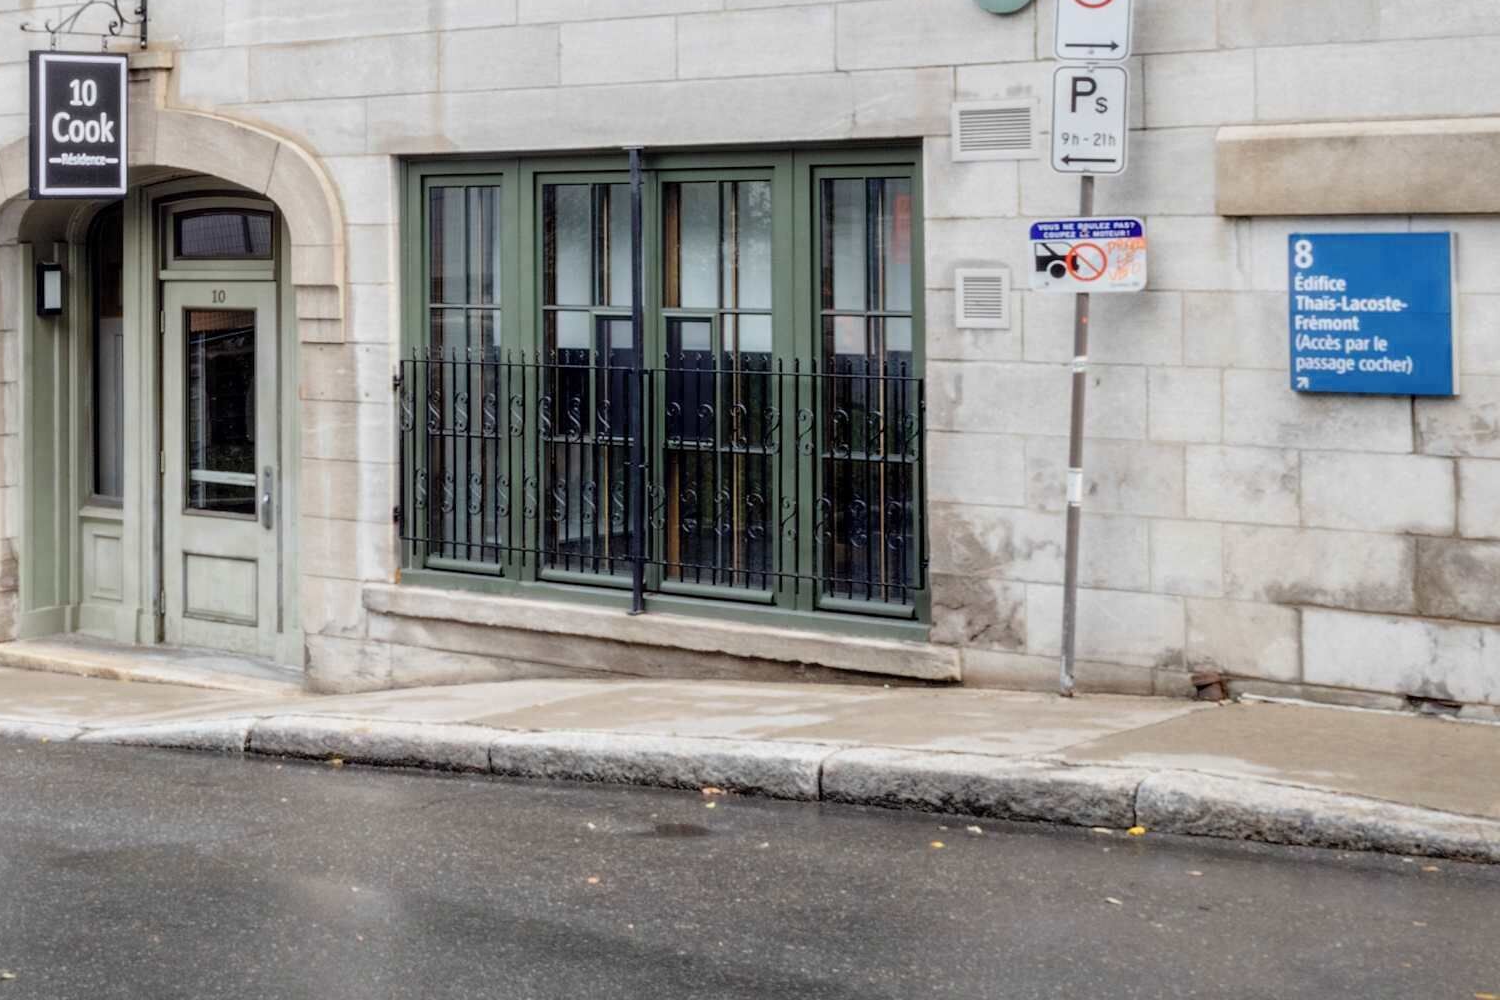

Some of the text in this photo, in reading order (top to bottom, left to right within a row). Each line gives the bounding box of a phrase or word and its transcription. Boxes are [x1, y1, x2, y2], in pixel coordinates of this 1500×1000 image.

[69, 79, 98, 107] 10
[52, 112, 115, 143] Cook
[1093, 132, 1116, 147] 21h
[1113, 221, 1136, 229] PAS?
[1043, 231, 1077, 239] COUPEZ
[1294, 239, 1314, 269] 8
[1294, 272, 1346, 291] Édifice
[211, 289, 226, 304] 10
[1295, 295, 1408, 312] Thaïs-Lacoste-
[1295, 315, 1360, 331] Frémont
[1295, 334, 1388, 354] (Accès par le
[1296, 355, 1413, 375] passage cocher)
